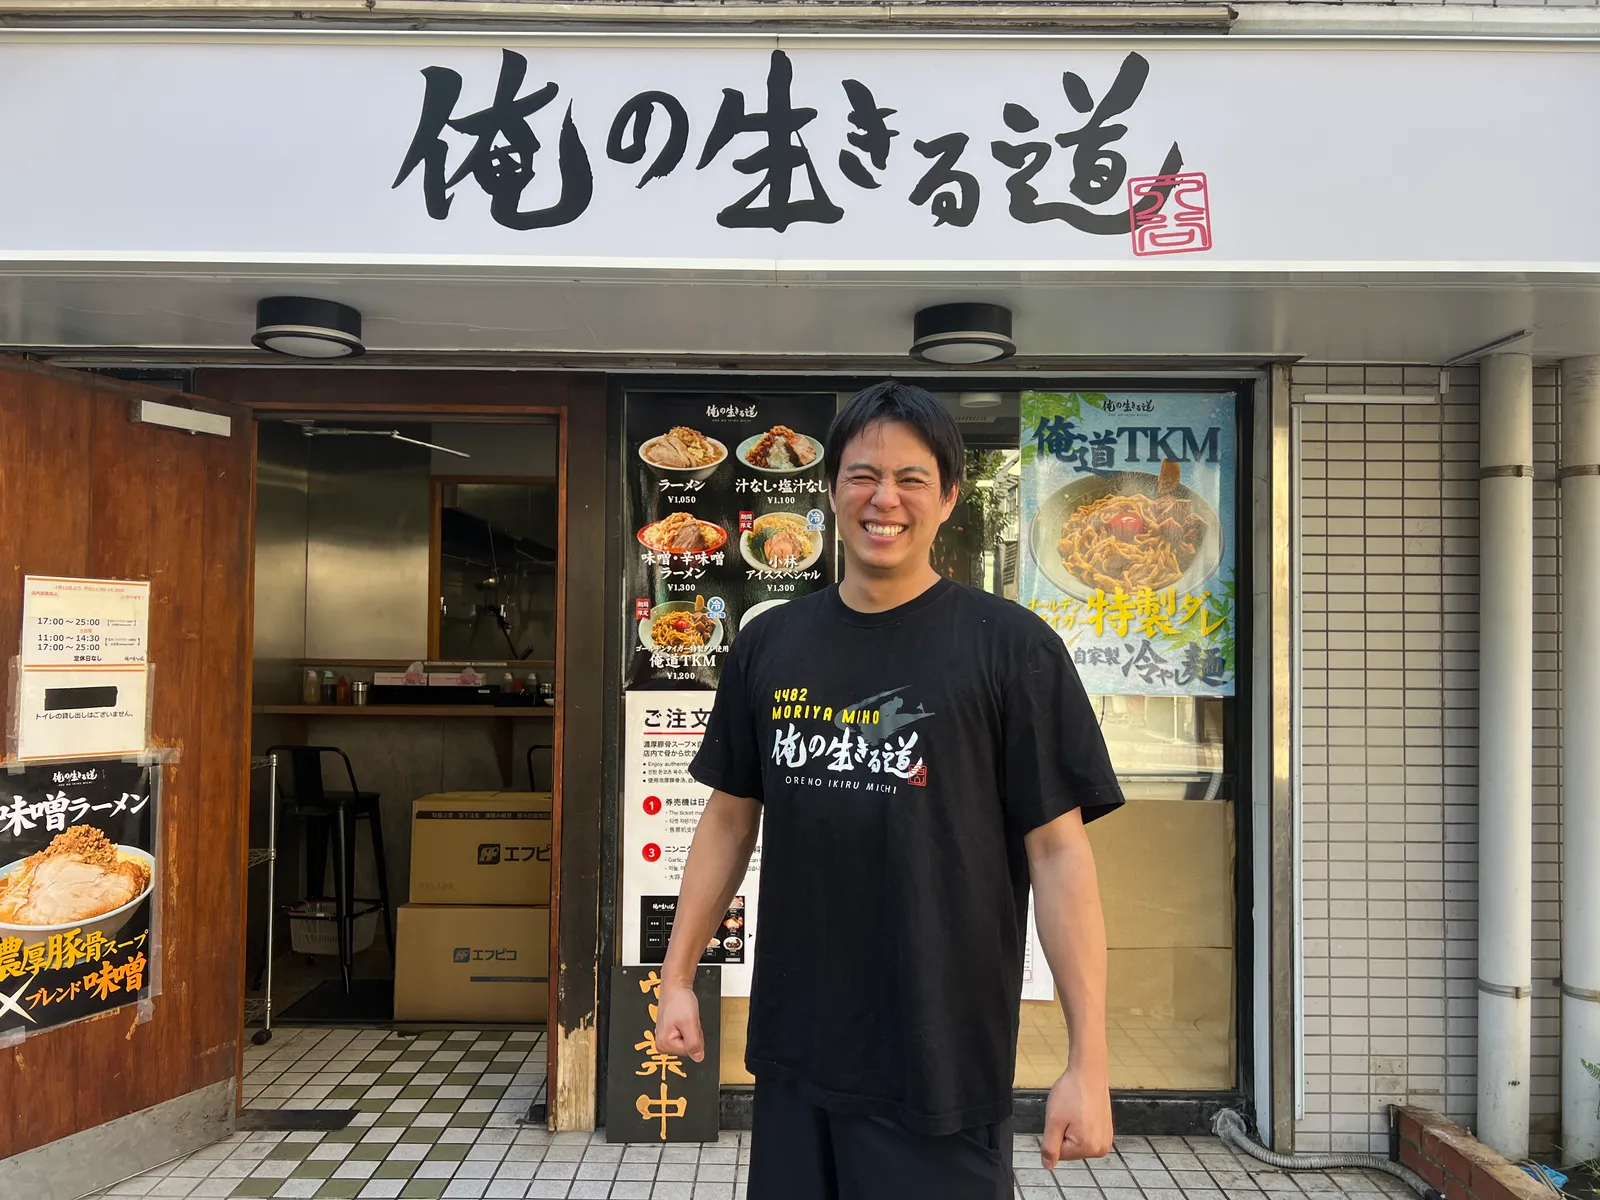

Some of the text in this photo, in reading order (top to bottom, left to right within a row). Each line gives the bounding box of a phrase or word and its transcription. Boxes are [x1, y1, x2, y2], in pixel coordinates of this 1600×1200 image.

[393, 48, 1183, 233] 俺の生きる道
[706, 404, 758, 418] 俺の生きる道
[1103, 399, 1155, 412] 俺の生きる道
[1032, 415, 1221, 478] 俺道TKM
[659, 479, 706, 492] ラーメン
[735, 479, 827, 493] 汁なし・塩汁なし
[668, 496, 696, 504] ¥1,050
[767, 496, 795, 504] ¥1,100
[810, 512, 821, 523] 冷
[641, 551, 725, 566] 味噌・辛味噌
[768, 555, 798, 568] 小林
[660, 567, 706, 579] ラーメン
[745, 570, 821, 580] アイススペシャル
[767, 584, 795, 592] ¥1,300
[710, 599, 722, 610] 冷
[1087, 586, 1227, 637] 特製ダレ
[649, 654, 716, 668] 俺道TKM
[1074, 646, 1121, 667] 自家製
[666, 672, 696, 680] ¥1,200
[774, 688, 808, 702] 4482
[35, 711, 134, 720] トイレの貸し出しはございません。
[772, 705, 881, 725] MORIYA MIHO
[771, 722, 924, 778] 俺の生きる道
[52, 768, 98, 783] 俺の生きる道
[785, 776, 897, 795] ORENO IKIRU MICHI
[649, 801, 655, 810] 1
[0, 790, 150, 836] 味噌ラーメン
[648, 848, 655, 857] 3
[472, 948, 517, 961] エフピコ
[25, 952, 147, 1010] ブレンド味噌
